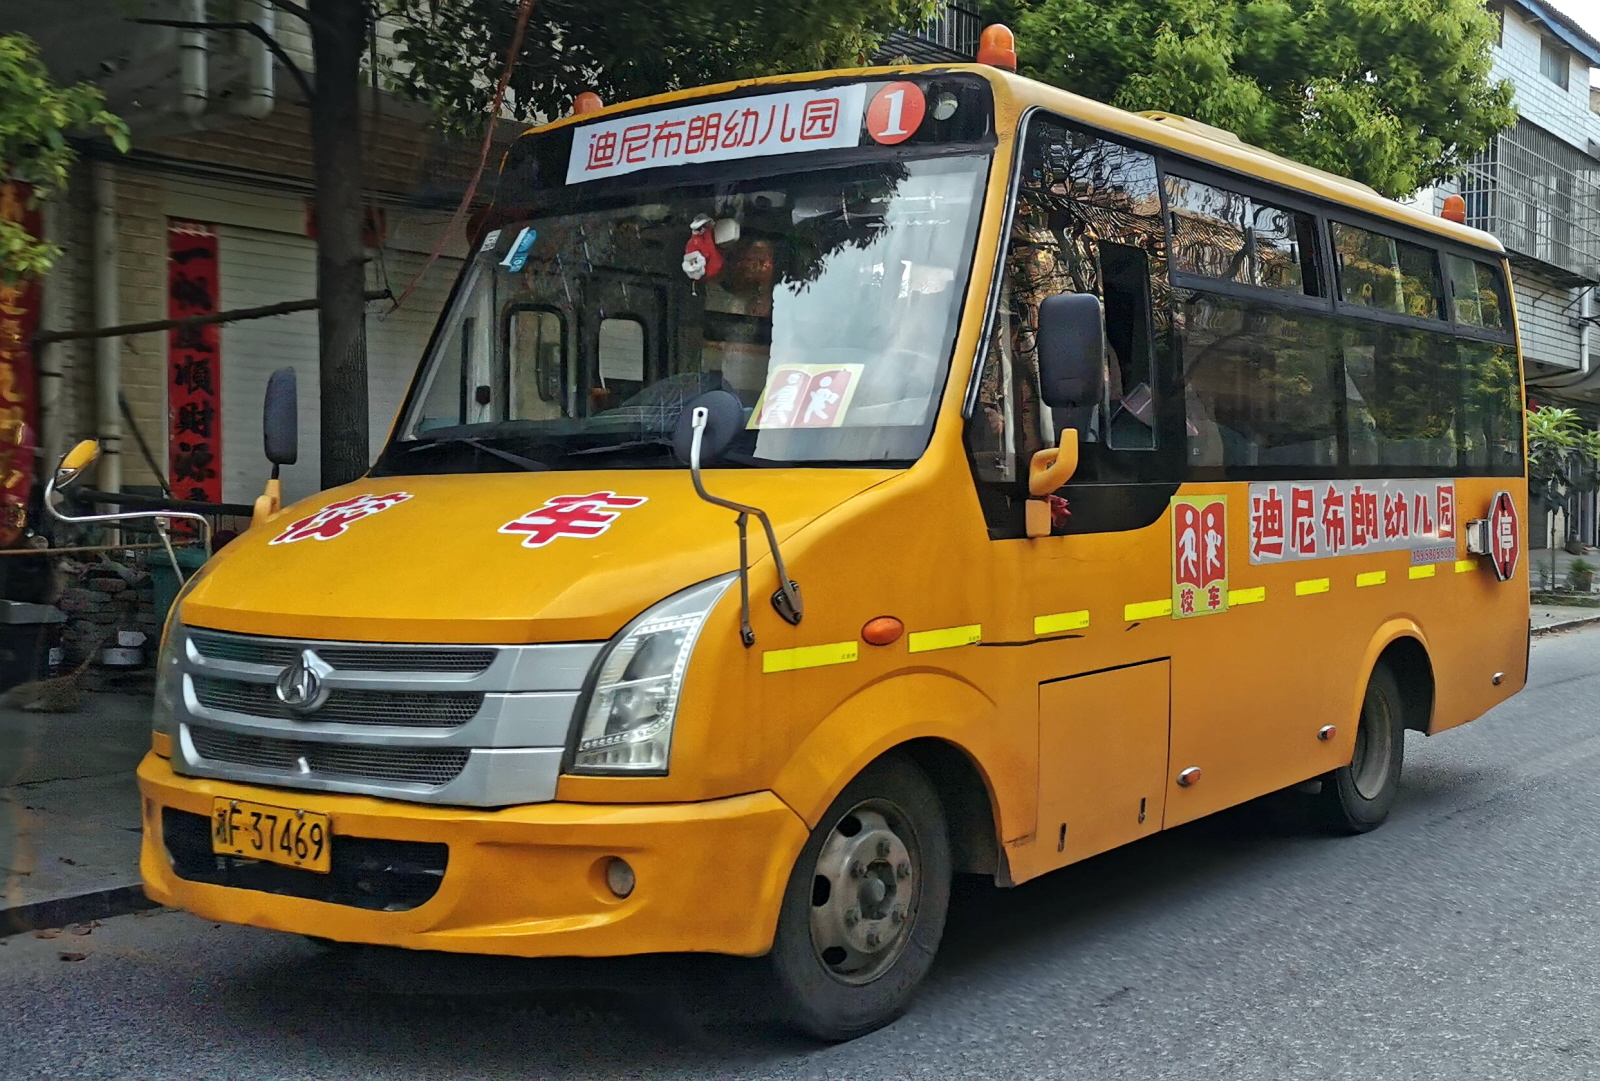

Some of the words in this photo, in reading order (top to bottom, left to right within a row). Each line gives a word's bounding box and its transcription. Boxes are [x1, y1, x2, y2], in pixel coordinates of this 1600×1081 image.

[584, 97, 840, 172] 迪尼布朗幼儿园
[876, 89, 909, 138] 1
[1251, 484, 1456, 560] 迪尼布朗幼儿园
[1495, 509, 1514, 563] 停
